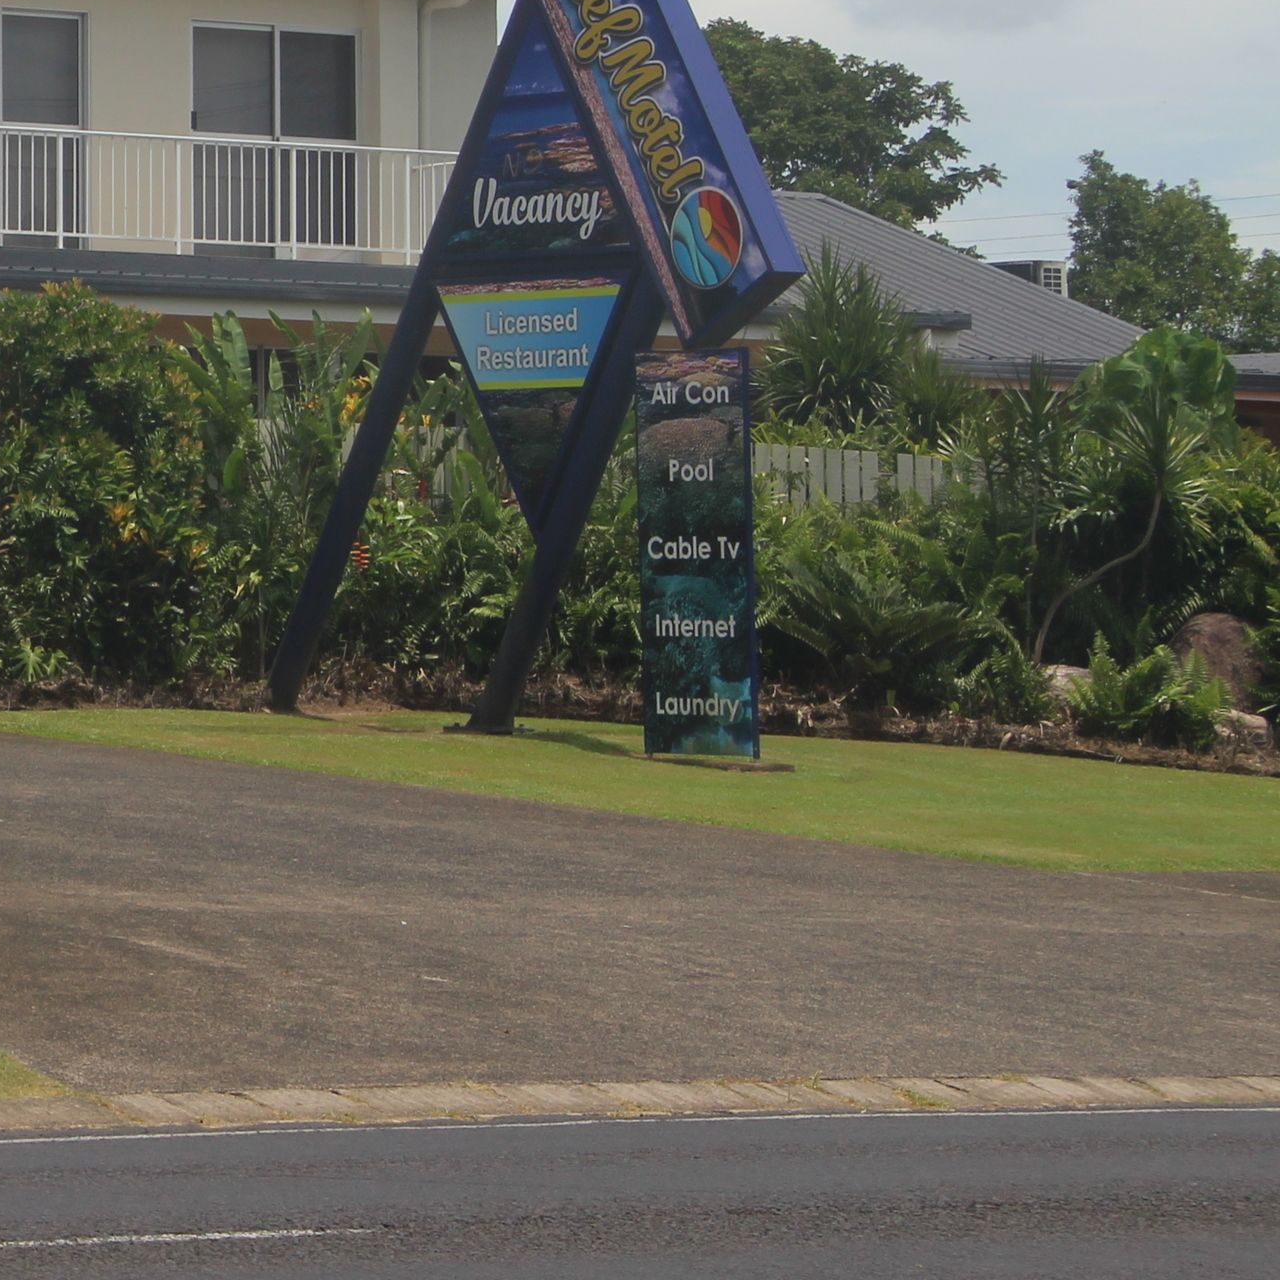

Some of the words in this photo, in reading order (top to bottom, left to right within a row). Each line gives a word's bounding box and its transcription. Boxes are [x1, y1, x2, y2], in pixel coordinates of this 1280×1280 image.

[602, 36, 704, 203] Motel
[473, 177, 602, 240] Vacancy
[485, 307, 578, 335] Licensed
[476, 343, 589, 371] Restaurant
[651, 381, 678, 406] Air
[684, 380, 730, 404] Con
[668, 459, 714, 482] Pool
[647, 536, 712, 560] Cable
[716, 536, 741, 560] Tv
[655, 615, 736, 638] Internet
[656, 692, 740, 721] Laundry
